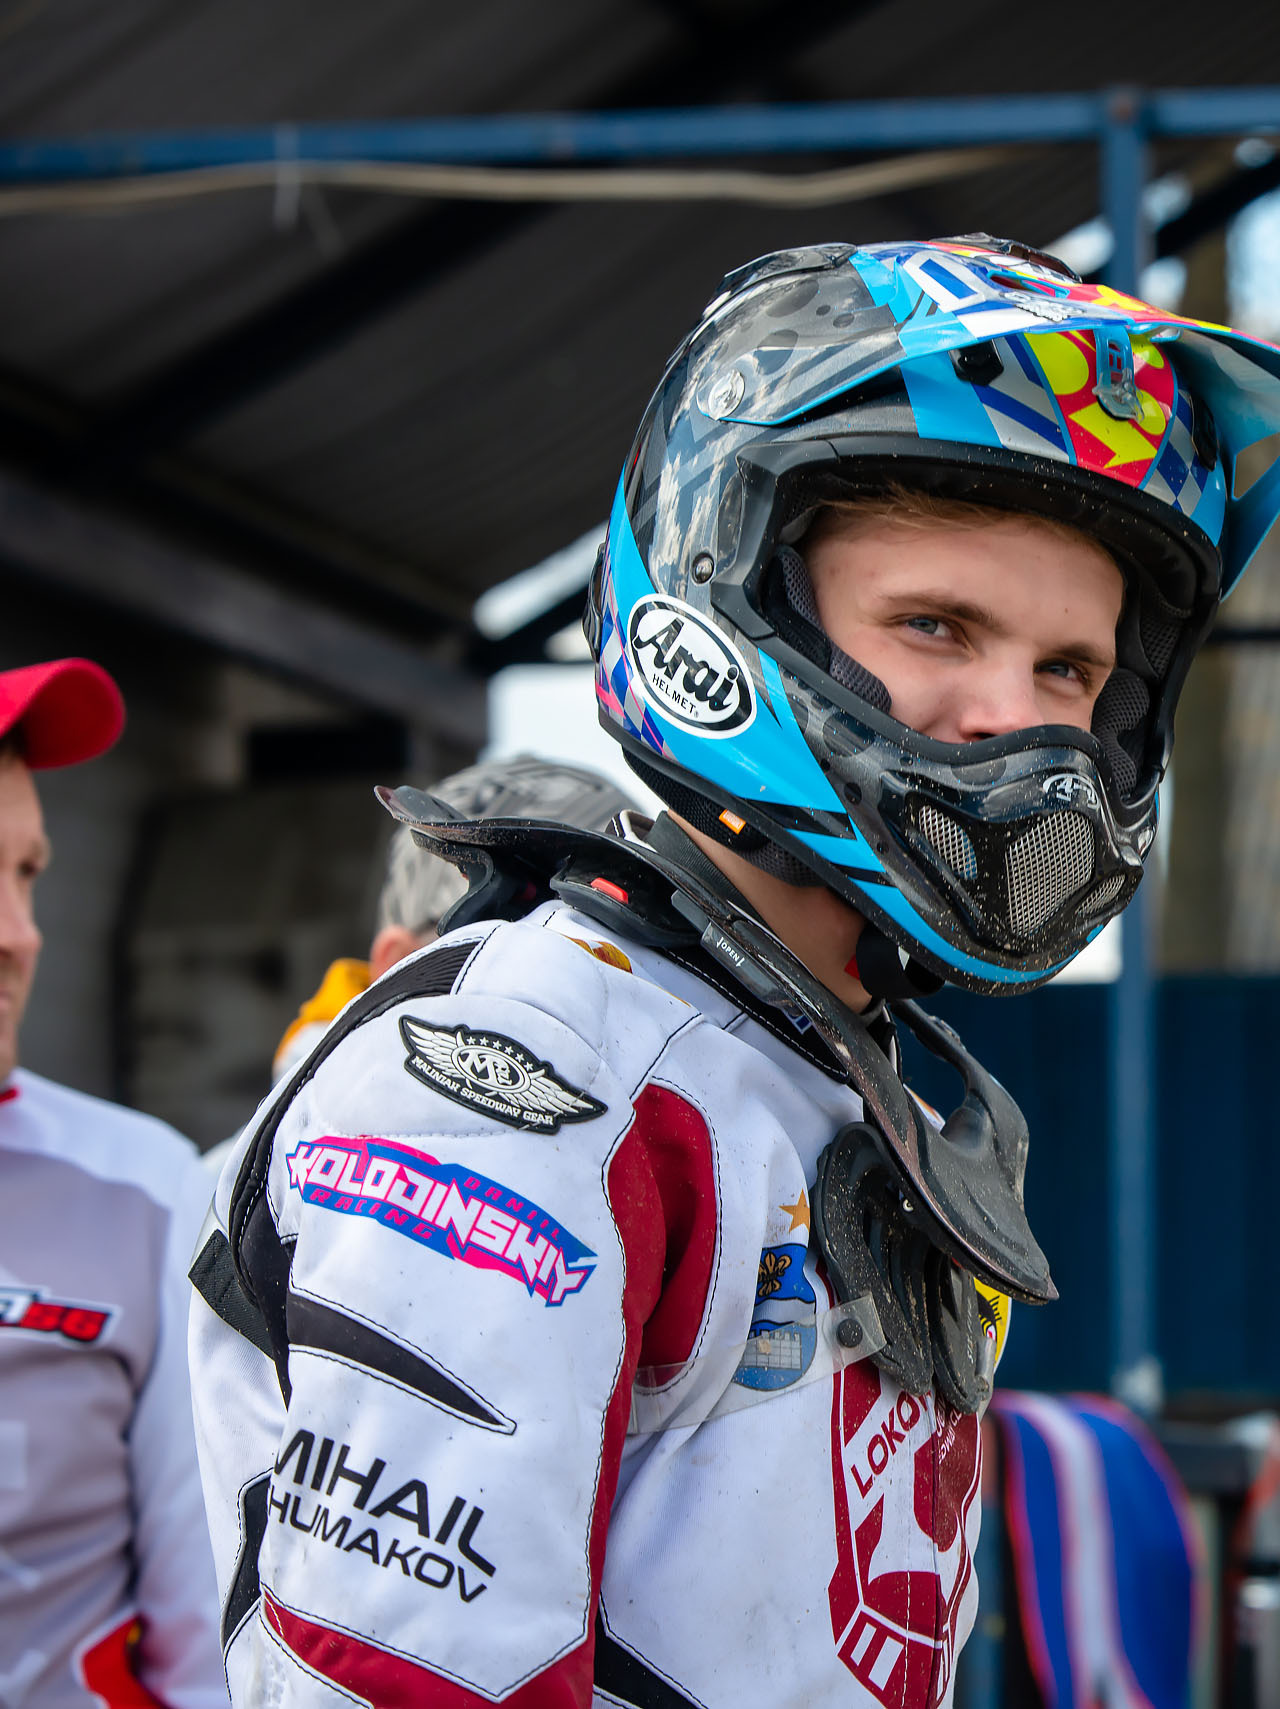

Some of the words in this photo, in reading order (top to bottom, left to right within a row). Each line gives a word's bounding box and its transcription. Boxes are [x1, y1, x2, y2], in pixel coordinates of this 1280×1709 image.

[634, 617, 738, 712] Arai
[652, 673, 697, 714] HELMET
[722, 941, 741, 962] OPEN
[460, 1086, 521, 1117] SPEEDWAY
[522, 1110, 554, 1126] GEAR
[310, 1188, 435, 1240] RACING
[464, 1176, 561, 1240] DANIIL
[274, 1429, 496, 1577] MIHAIL
